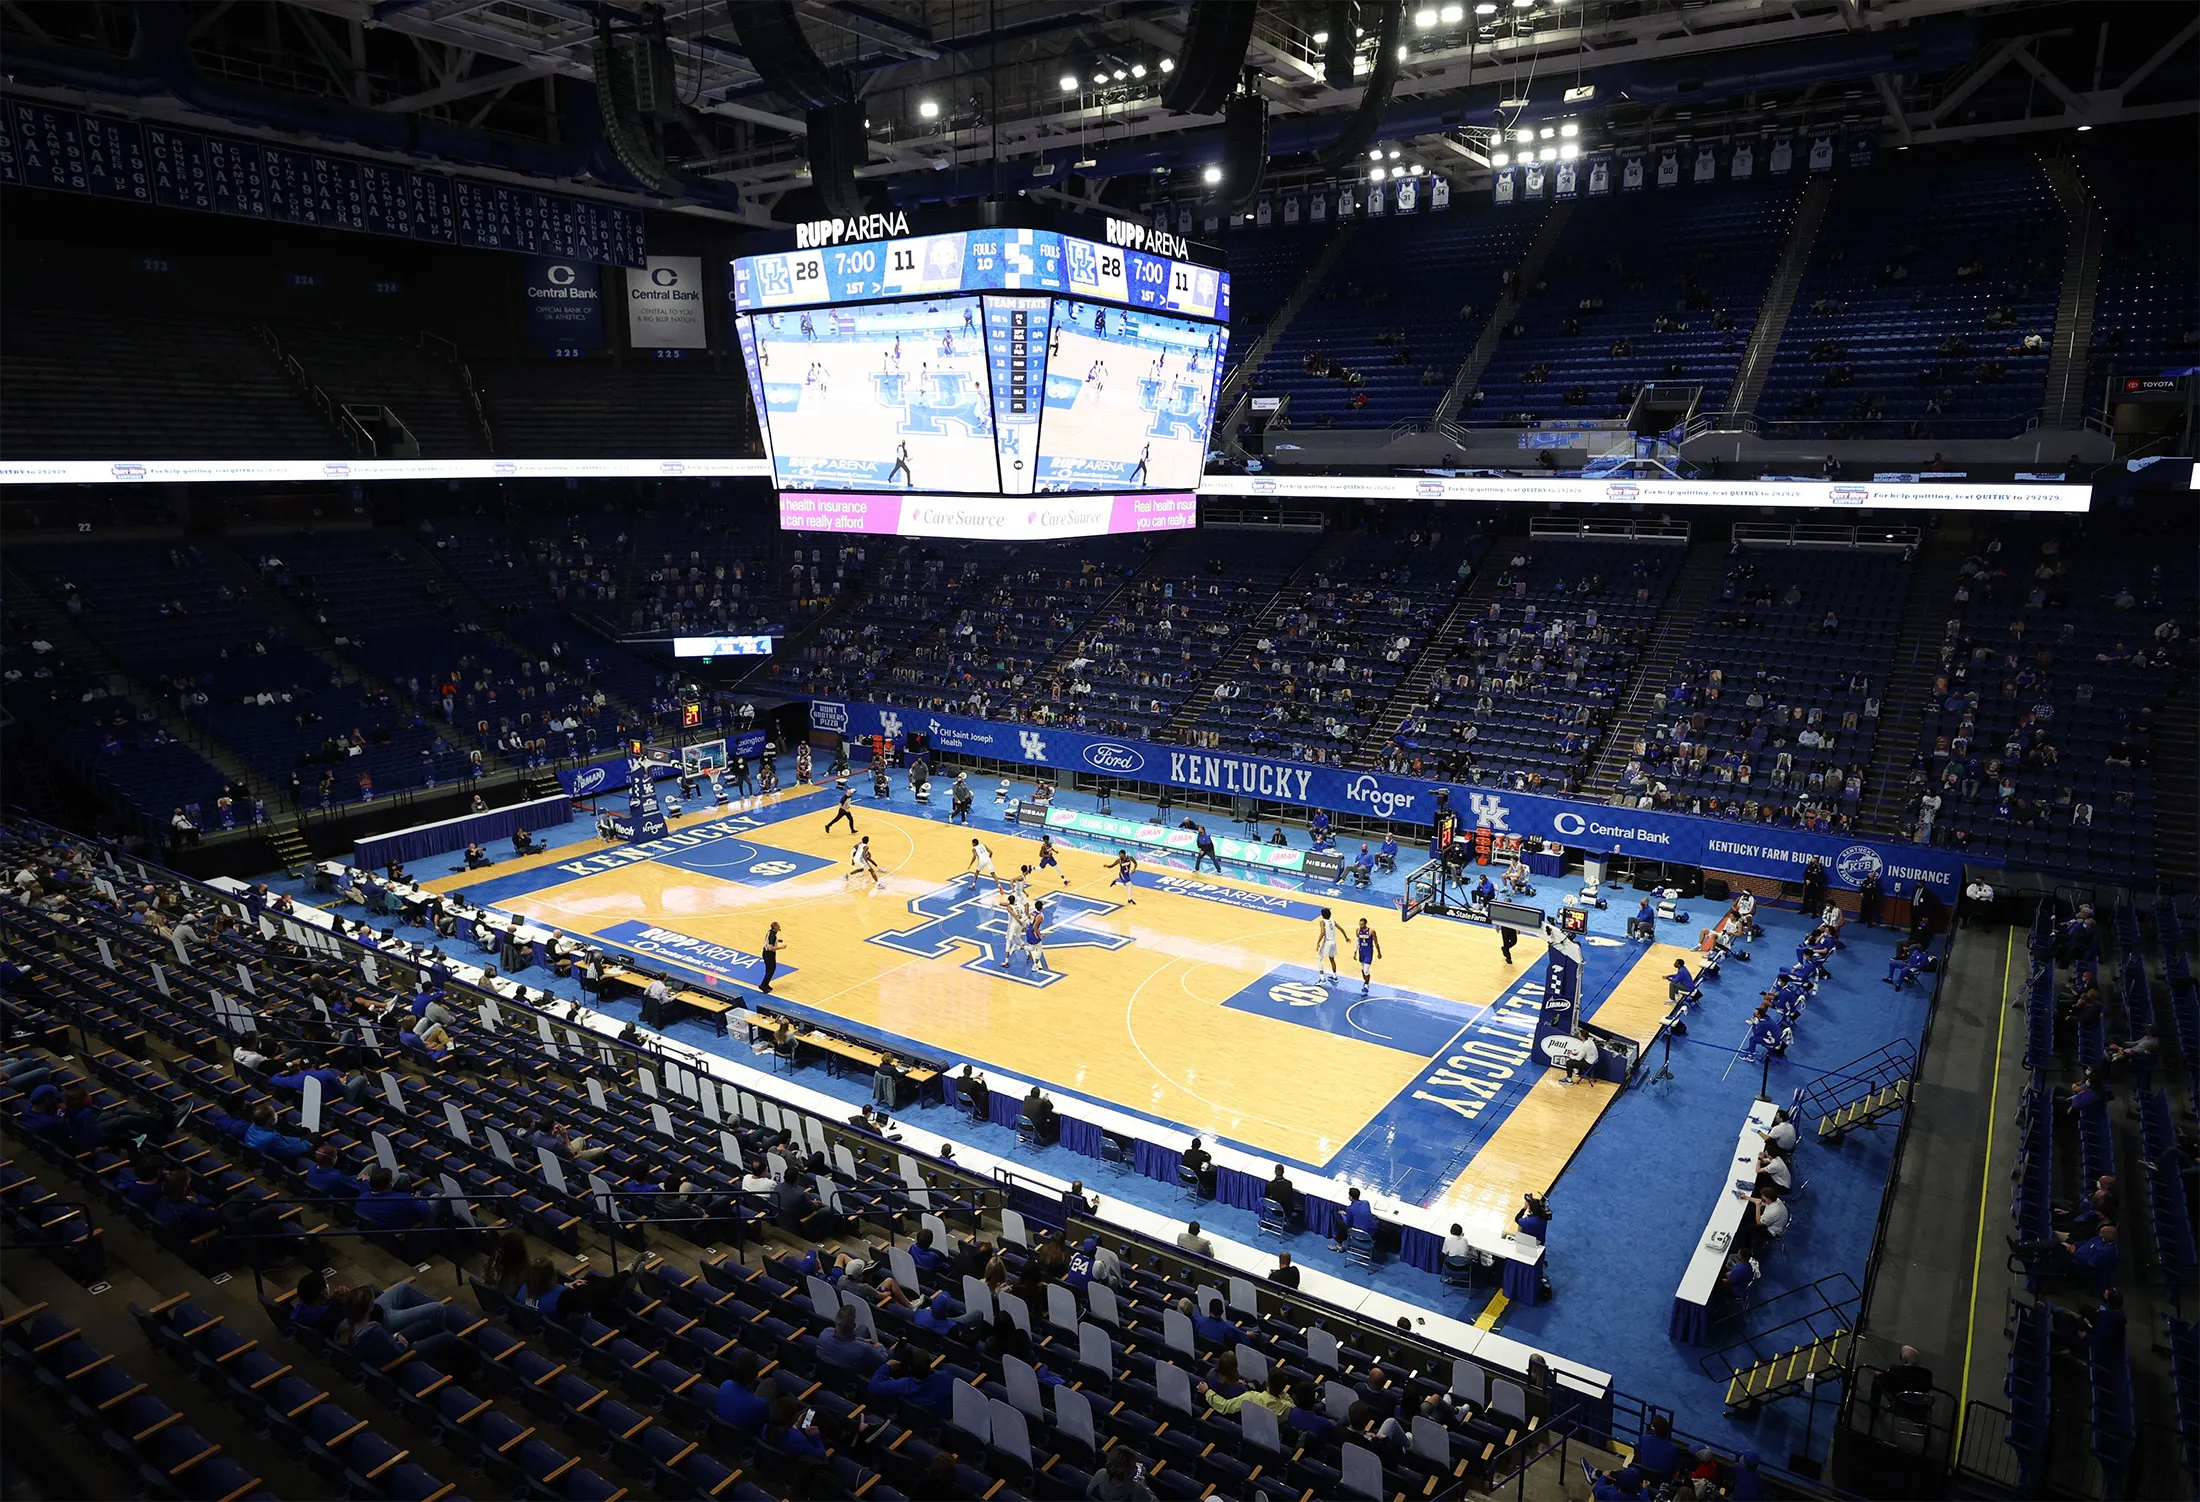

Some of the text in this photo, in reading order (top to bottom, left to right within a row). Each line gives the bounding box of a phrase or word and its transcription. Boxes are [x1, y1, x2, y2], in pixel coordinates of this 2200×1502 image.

[17, 107, 42, 167] NCAA
[84, 118, 106, 177] NCAA
[43, 114, 65, 184] CHAMPION
[151, 131, 172, 188] NCAA
[65, 132, 86, 188] 1958
[211, 142, 230, 196] NCAA
[129, 144, 147, 198] 1966
[192, 154, 208, 206] 1975
[230, 148, 248, 211] CHAMPION
[267, 152, 283, 204] NCAA
[249, 161, 264, 213] 1978
[315, 160, 331, 210] NCAA
[364, 167, 380, 217] NCAA
[1437, 188, 1445, 196] 34
[302, 172, 316, 221] 1984
[349, 179, 362, 228] 1993
[380, 172, 395, 231] CHAMPION
[412, 176, 425, 223] NCAA
[457, 183, 471, 230] NCAA
[396, 186, 408, 233] 1996
[441, 194, 453, 239] 1997
[473, 188, 486, 243] CHAMPION
[498, 190, 510, 235] NCAA
[538, 197, 550, 240] NCAA
[487, 201, 498, 245] 1998
[525, 207, 536, 250] 2011
[552, 201, 562, 252] CHAMPION
[577, 203, 588, 246] NCAA
[613, 210, 623, 252] NCAA
[796, 211, 910, 249] RUPP ARENA
[564, 213, 574, 256] 2012
[600, 220, 609, 261] 2014
[636, 225, 645, 265] 2015
[1106, 217, 1189, 260] RUPP ARENA
[973, 240, 996, 257] FOULS
[1040, 243, 1060, 259] FOULS
[796, 261, 819, 281] 28
[834, 249, 876, 276] 7:00
[894, 250, 915, 271] 11
[977, 258, 994, 271] 10
[1046, 260, 1054, 272] 6
[1102, 256, 1121, 277] 28
[1133, 258, 1164, 285] 7:00
[1175, 272, 1188, 291] 11
[528, 287, 598, 299] Central Bank
[632, 289, 699, 300] Central Bank
[846, 282, 865, 295] 1ST
[1141, 290, 1154, 302] 1ST
[988, 297, 1047, 309] TEAM STATS
[556, 349, 579, 357] 225
[658, 350, 680, 358] 225
[827, 459, 878, 472] ARENA
[1085, 459, 1124, 472] ARENA
[786, 499, 867, 513] health insurance
[1134, 500, 1175, 512] Real health
[786, 515, 864, 530] can really afford
[923, 509, 1004, 527] CareSource
[1041, 510, 1101, 526] CareSource
[1137, 515, 1150, 531] you
[1152, 515, 1166, 527] can
[1167, 514, 1186, 529] really
[686, 712, 698, 724] 27
[813, 711, 844, 721] BROTHERS
[820, 705, 837, 714] HUNT
[820, 718, 839, 727] PIZZA
[879, 710, 902, 738] UK
[940, 728, 993, 744] CHI Saint Joseph
[940, 737, 962, 748] Health
[1019, 731, 1048, 761] UK
[1093, 745, 1133, 769] Ford
[1170, 752, 1312, 800] KENTUCKY
[1347, 775, 1414, 818] Kroger
[1020, 808, 1045, 818] NISSAN
[1050, 812, 1075, 824] LIBMAN
[1469, 792, 1510, 831] UK
[643, 821, 664, 834] Kroger
[1135, 828, 1162, 839] LIBMAN
[1442, 829, 1451, 847] 27
[1590, 822, 1670, 845] Central Bank
[557, 815, 765, 876] KENTUCKY
[1166, 833, 1193, 845] LIBMAN
[1267, 852, 1298, 863] LIBMAN
[1709, 839, 1832, 868] KENTUCKY FARM BURAU
[1842, 848, 1875, 858] KENTUCKY
[749, 860, 797, 876] SEC
[1305, 859, 1339, 870] NISSAN
[1850, 861, 1871, 871] KFB
[1888, 865, 1950, 884] INSURANCE
[1840, 870, 1854, 883] FARM
[1156, 876, 1289, 909] RUPP ARENA
[1187, 890, 1273, 912] Central Bank Center
[1455, 910, 1487, 923] StateFarm
[1568, 919, 1581, 928] 27
[637, 926, 760, 969] RUPP ARENA
[656, 946, 731, 974] Central Bank Center
[1545, 1000, 1569, 1010] LIBMAN
[1548, 1039, 1568, 1049] paul
[1071, 1257, 1090, 1276] 24
